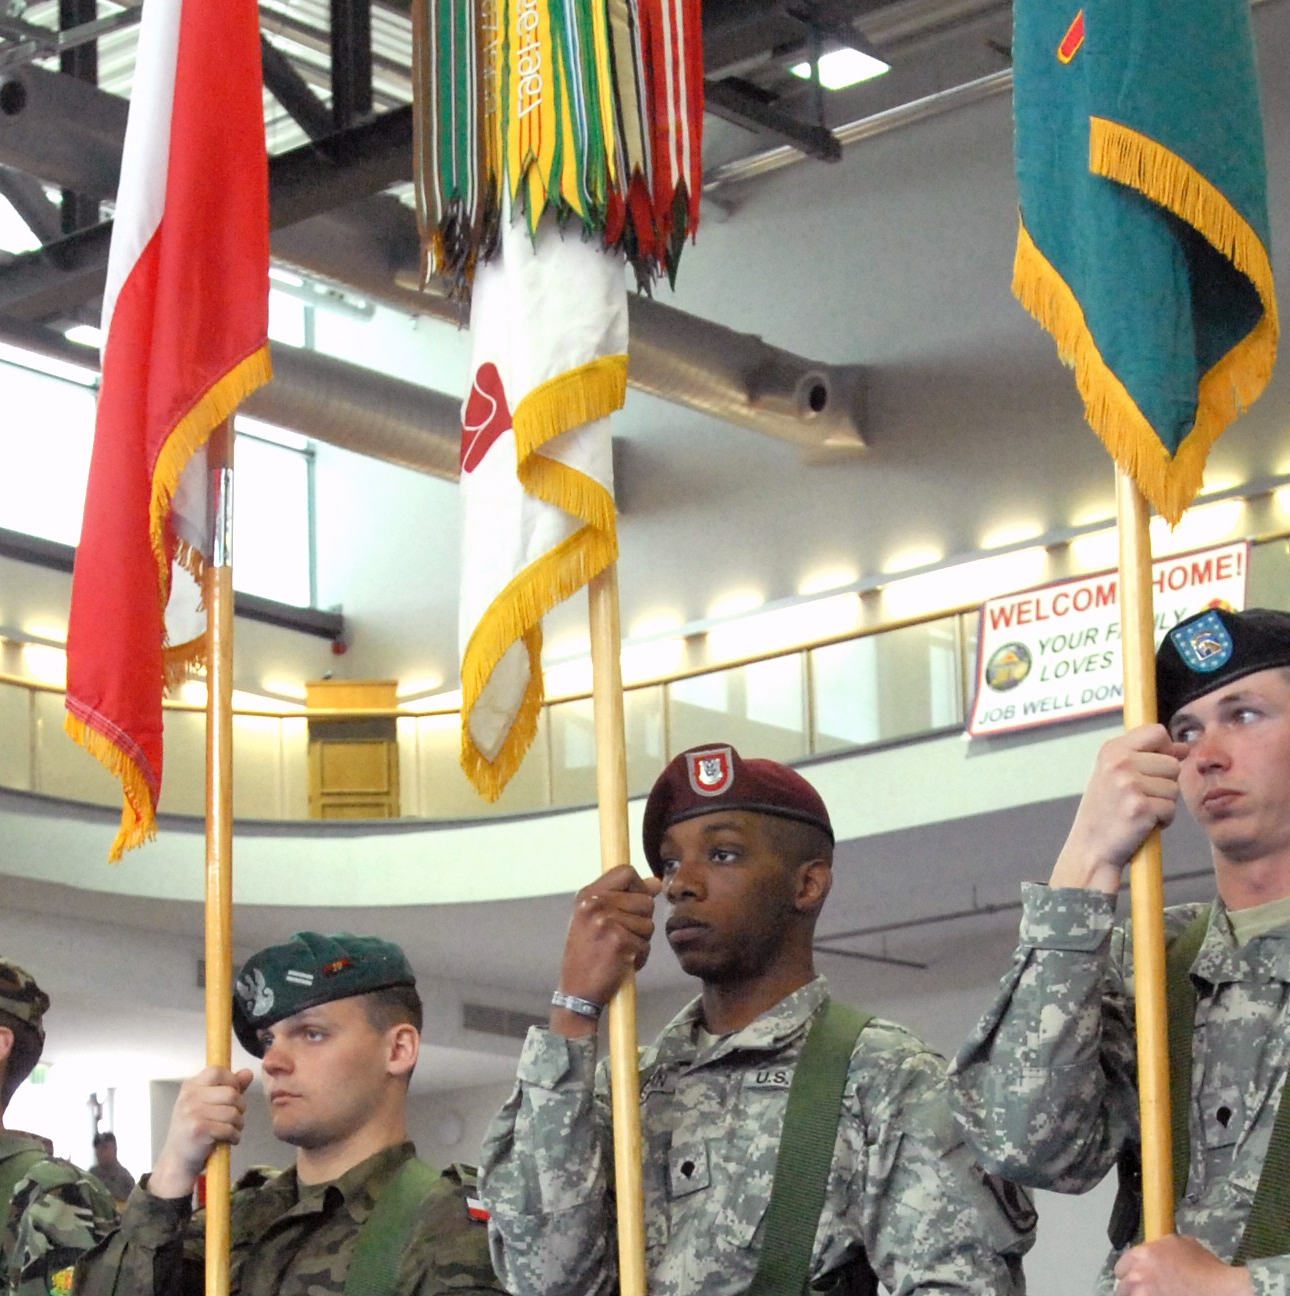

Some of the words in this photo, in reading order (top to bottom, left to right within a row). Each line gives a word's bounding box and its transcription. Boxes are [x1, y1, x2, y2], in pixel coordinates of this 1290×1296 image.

[989, 581, 1117, 631] WELCOM
[1038, 626, 1100, 656] YOUR
[1039, 650, 1115, 683] LOVES
[978, 705, 1016, 725] JOB
[1023, 693, 1074, 716] WELL
[1081, 682, 1123, 705] DON
[756, 1070, 790, 1085] U.S.
